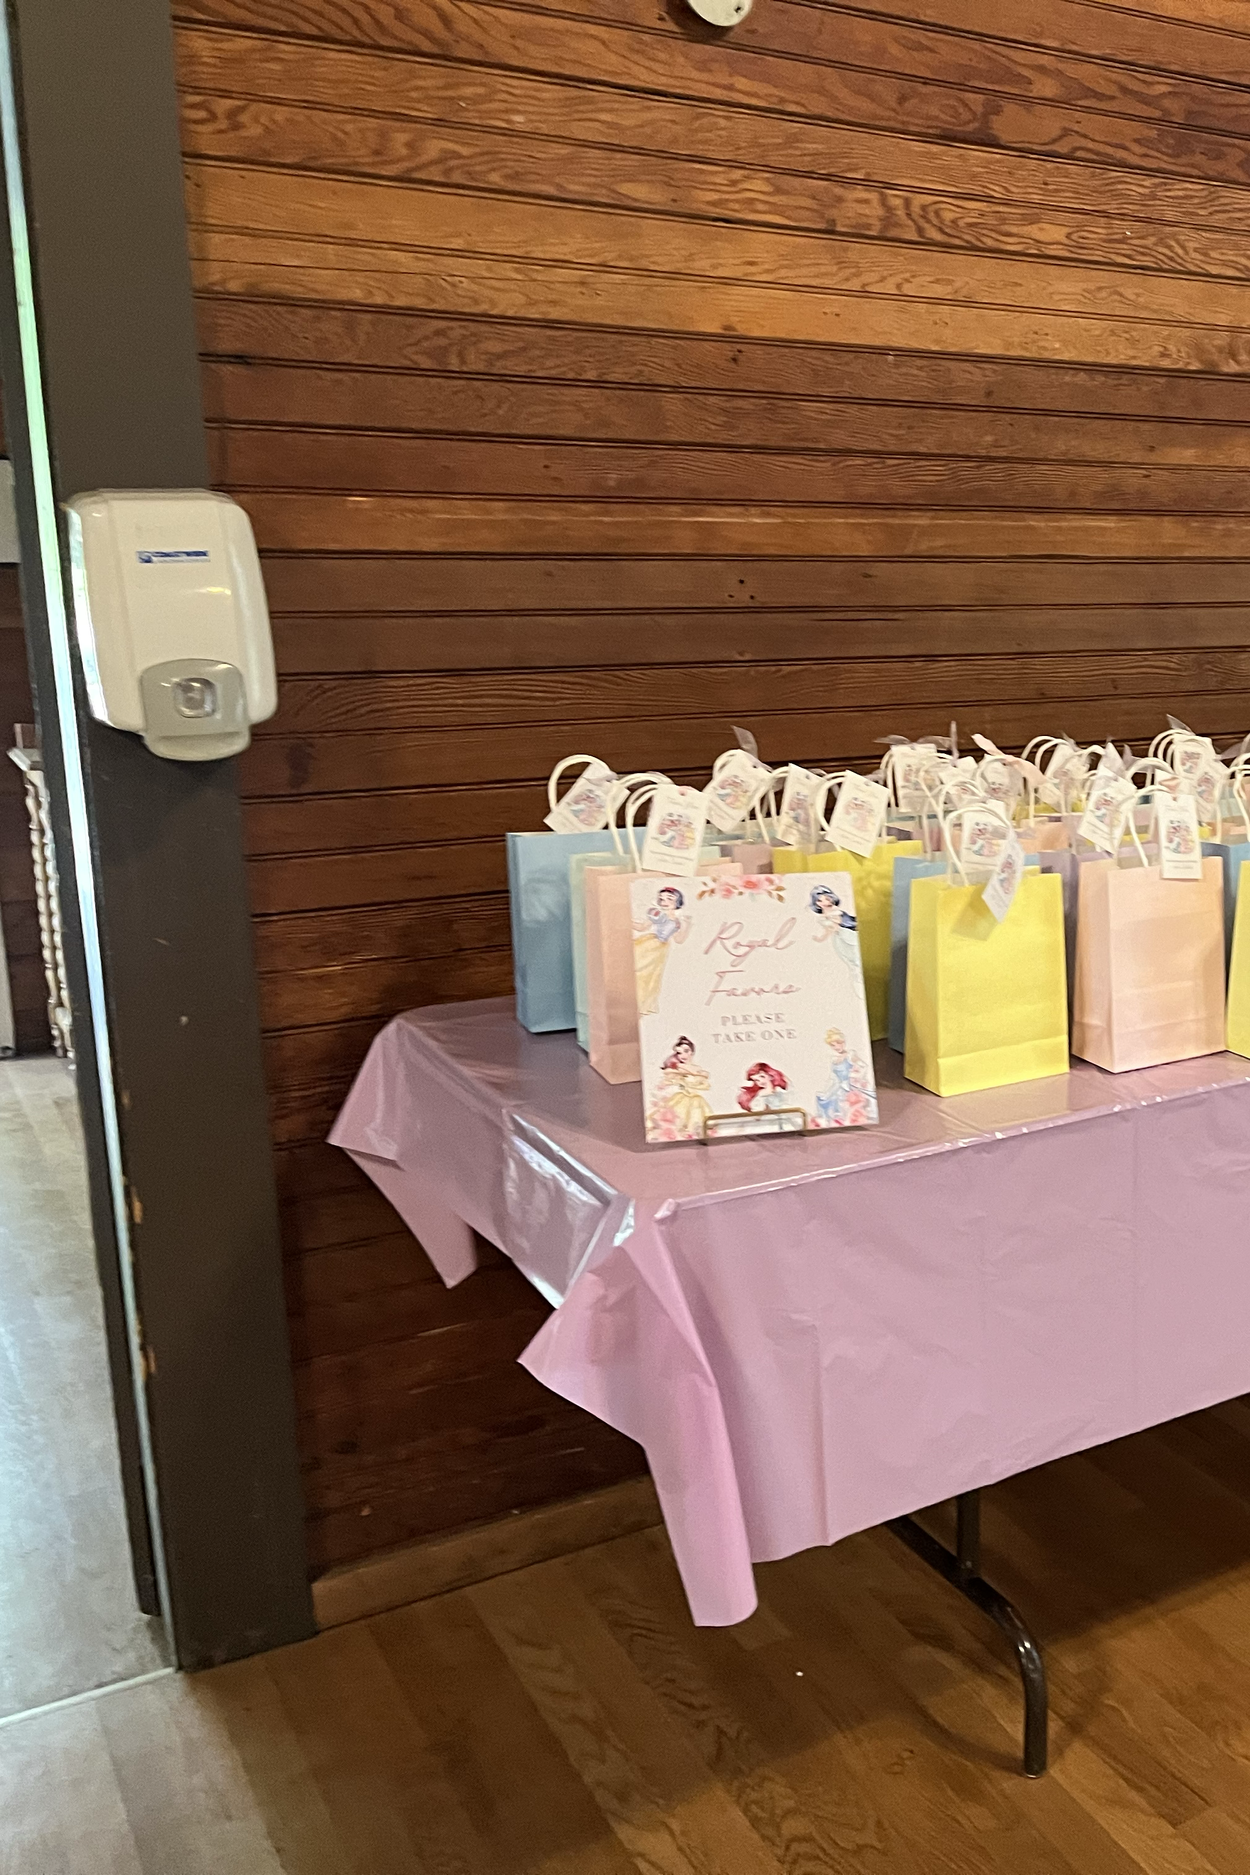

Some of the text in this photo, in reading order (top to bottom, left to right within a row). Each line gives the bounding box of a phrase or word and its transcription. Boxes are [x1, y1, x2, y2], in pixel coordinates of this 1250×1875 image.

[704, 917, 797, 967] Royal
[705, 970, 801, 1006] Favors
[721, 1013, 784, 1026] PLEASE
[712, 1029, 797, 1044] TAKE ONE
